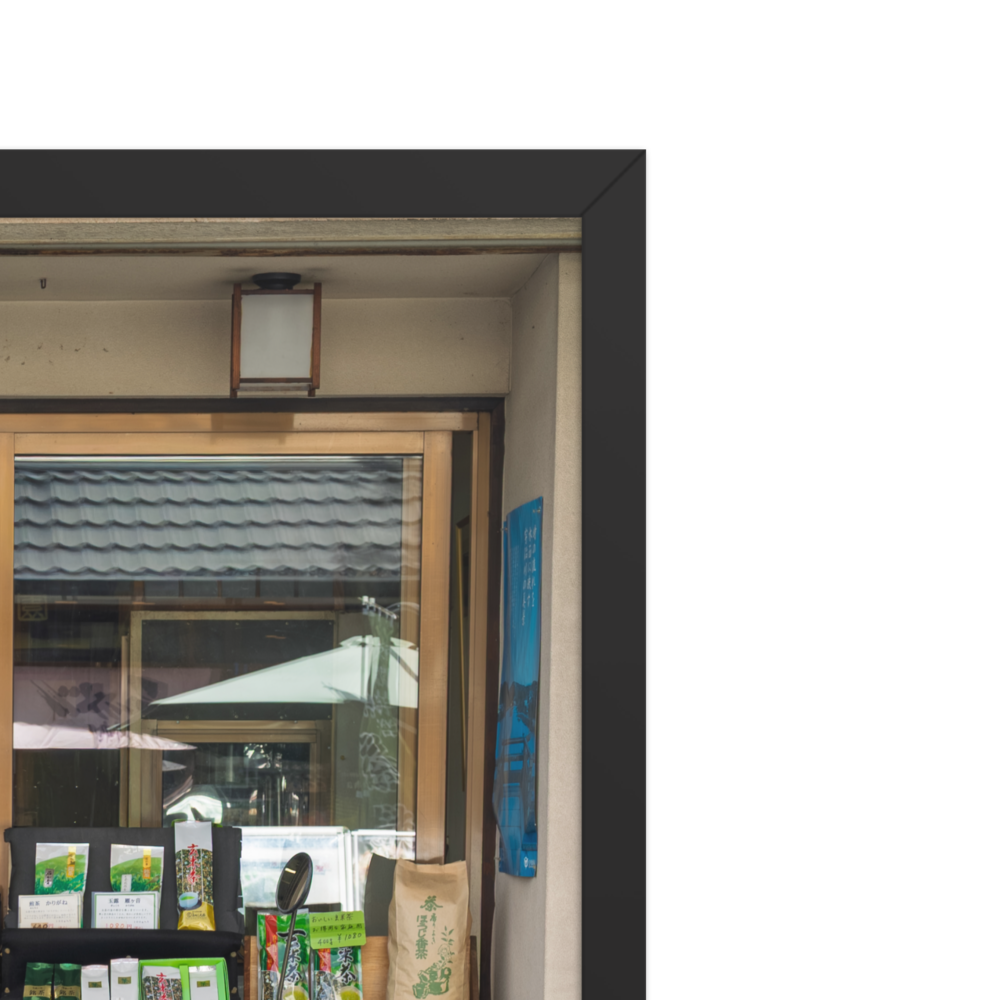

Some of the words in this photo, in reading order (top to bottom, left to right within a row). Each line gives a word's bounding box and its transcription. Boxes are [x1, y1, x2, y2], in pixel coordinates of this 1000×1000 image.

[187, 844, 201, 886] 玄米茶
[420, 895, 443, 911] 茶
[415, 915, 428, 960] ほうじ番茶
[336, 945, 357, 984] 米茶
